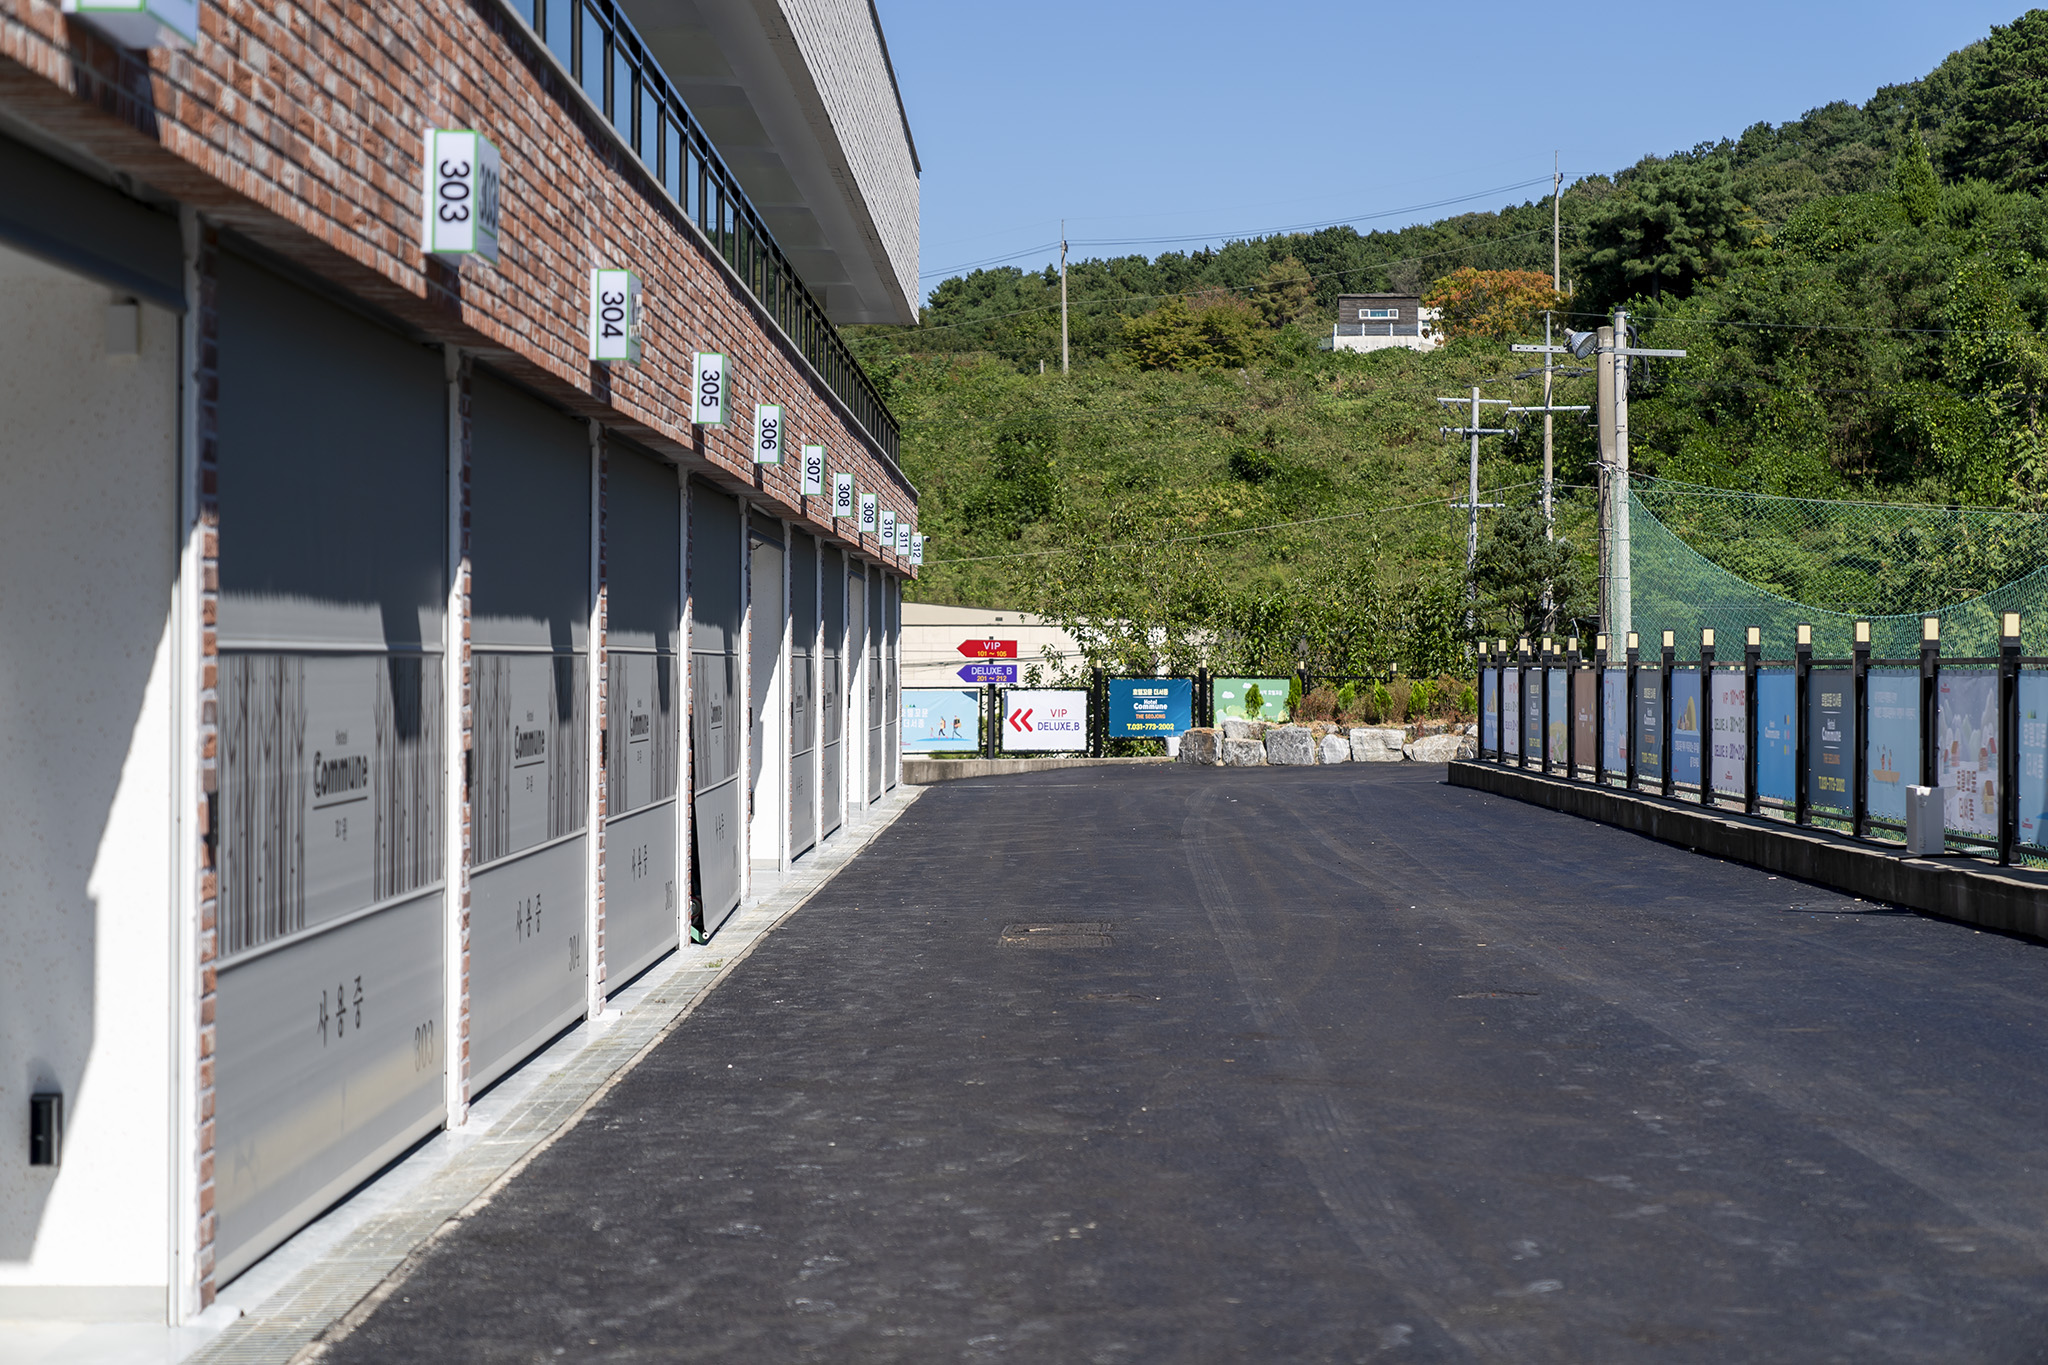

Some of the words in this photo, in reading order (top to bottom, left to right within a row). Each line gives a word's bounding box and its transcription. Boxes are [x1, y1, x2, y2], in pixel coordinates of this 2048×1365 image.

[439, 160, 471, 223] 303
[601, 291, 625, 339] 304
[701, 370, 720, 407] 305
[761, 418, 777, 450] 306
[807, 457, 821, 484] 307
[838, 483, 850, 507] 308
[863, 502, 874, 524] 309
[883, 519, 893, 538] 310
[899, 531, 908, 549] 311
[912, 542, 921, 559] 312
[983, 641, 1001, 650] VIP
[1050, 709, 1068, 718] VIP
[1133, 702, 1168, 710] Commune
[515, 725, 544, 760] Commune
[313, 750, 368, 798] Commune
[516, 893, 542, 944] 사용중
[316, 975, 363, 1048] 사용중
[414, 1020, 434, 1072] 303
